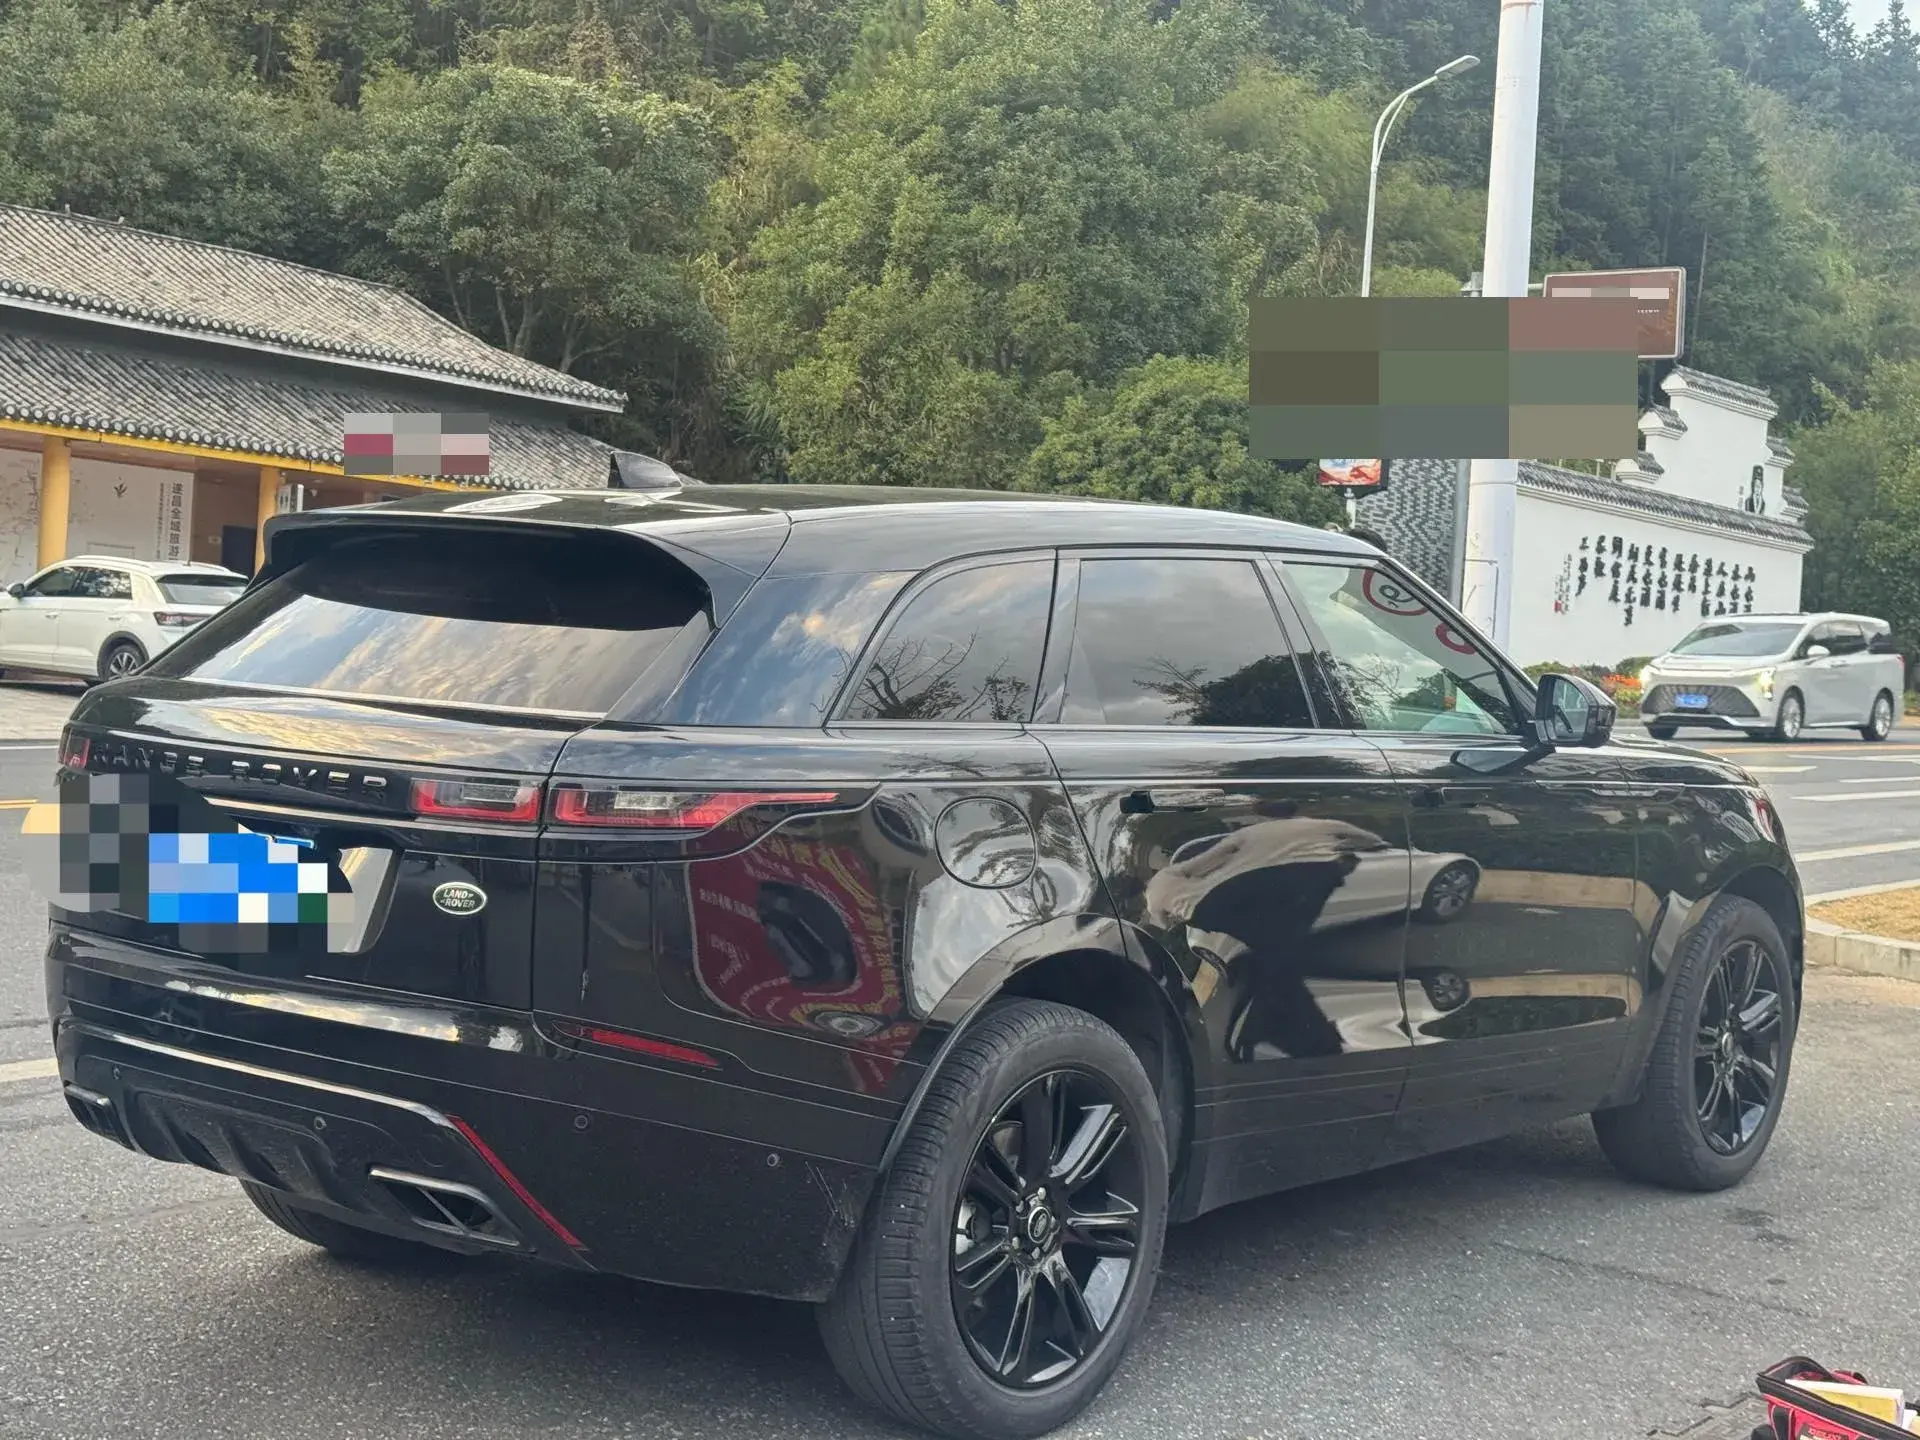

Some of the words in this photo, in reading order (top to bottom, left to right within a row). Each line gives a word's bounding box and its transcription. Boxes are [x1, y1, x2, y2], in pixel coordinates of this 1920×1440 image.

[168, 482, 184, 560] 遂昌全域旅游
[91, 742, 207, 777] RANGE
[229, 759, 389, 801] ROVER
[443, 888, 469, 899] LAND
[444, 898, 476, 908] ROVER
